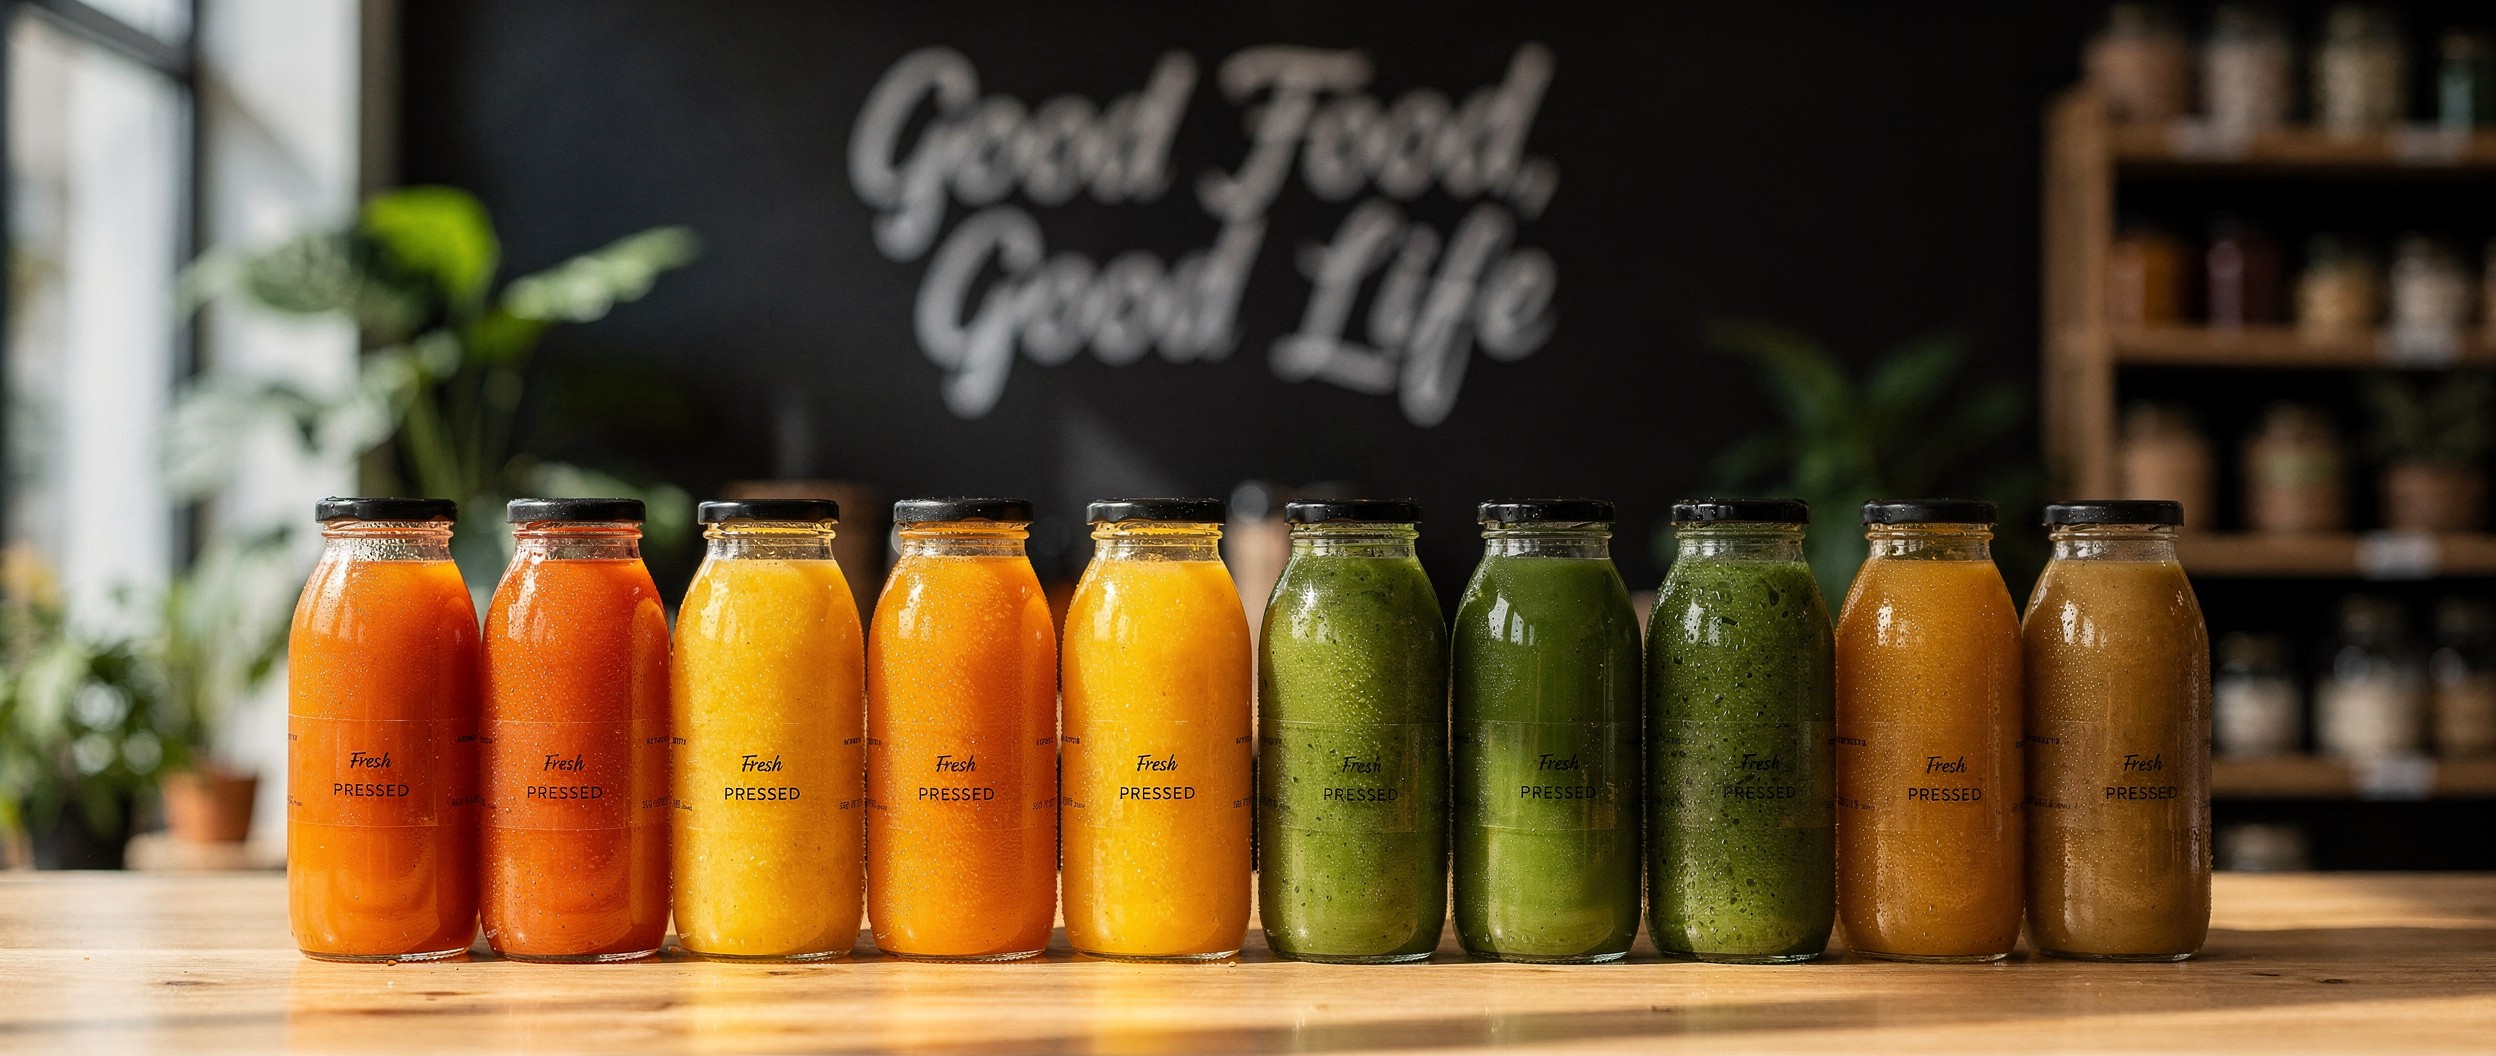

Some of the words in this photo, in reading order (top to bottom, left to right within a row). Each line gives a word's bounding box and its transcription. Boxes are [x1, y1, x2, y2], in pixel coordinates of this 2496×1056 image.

[848, 46, 1198, 261] Good
[1197, 42, 1560, 221] Food,
[915, 206, 1266, 418] Good
[1269, 202, 1556, 428] Life
[349, 752, 392, 769] Fresh
[543, 754, 585, 771] Fresh
[741, 755, 783, 772] Fresh
[935, 755, 977, 772] Fresh
[1136, 755, 1178, 771] Fresh
[1342, 757, 1383, 773] Fresh
[1539, 754, 1579, 771] Fresh
[1739, 754, 1780, 771] Fresh
[1926, 757, 1967, 773] Fresh
[2123, 755, 2163, 772] Fresh
[333, 784, 409, 797] PRESSED
[527, 786, 602, 799] PRESSED
[725, 788, 800, 800] PRESSED
[919, 788, 994, 801] PRESSED
[1120, 787, 1195, 800] PRESSED
[1324, 788, 1398, 801] PRESSED
[1521, 786, 1596, 799] PRESSED
[1723, 786, 1795, 799] PRESSED
[1908, 788, 1982, 801] PRESSED
[2107, 787, 2177, 800] PRESSED
